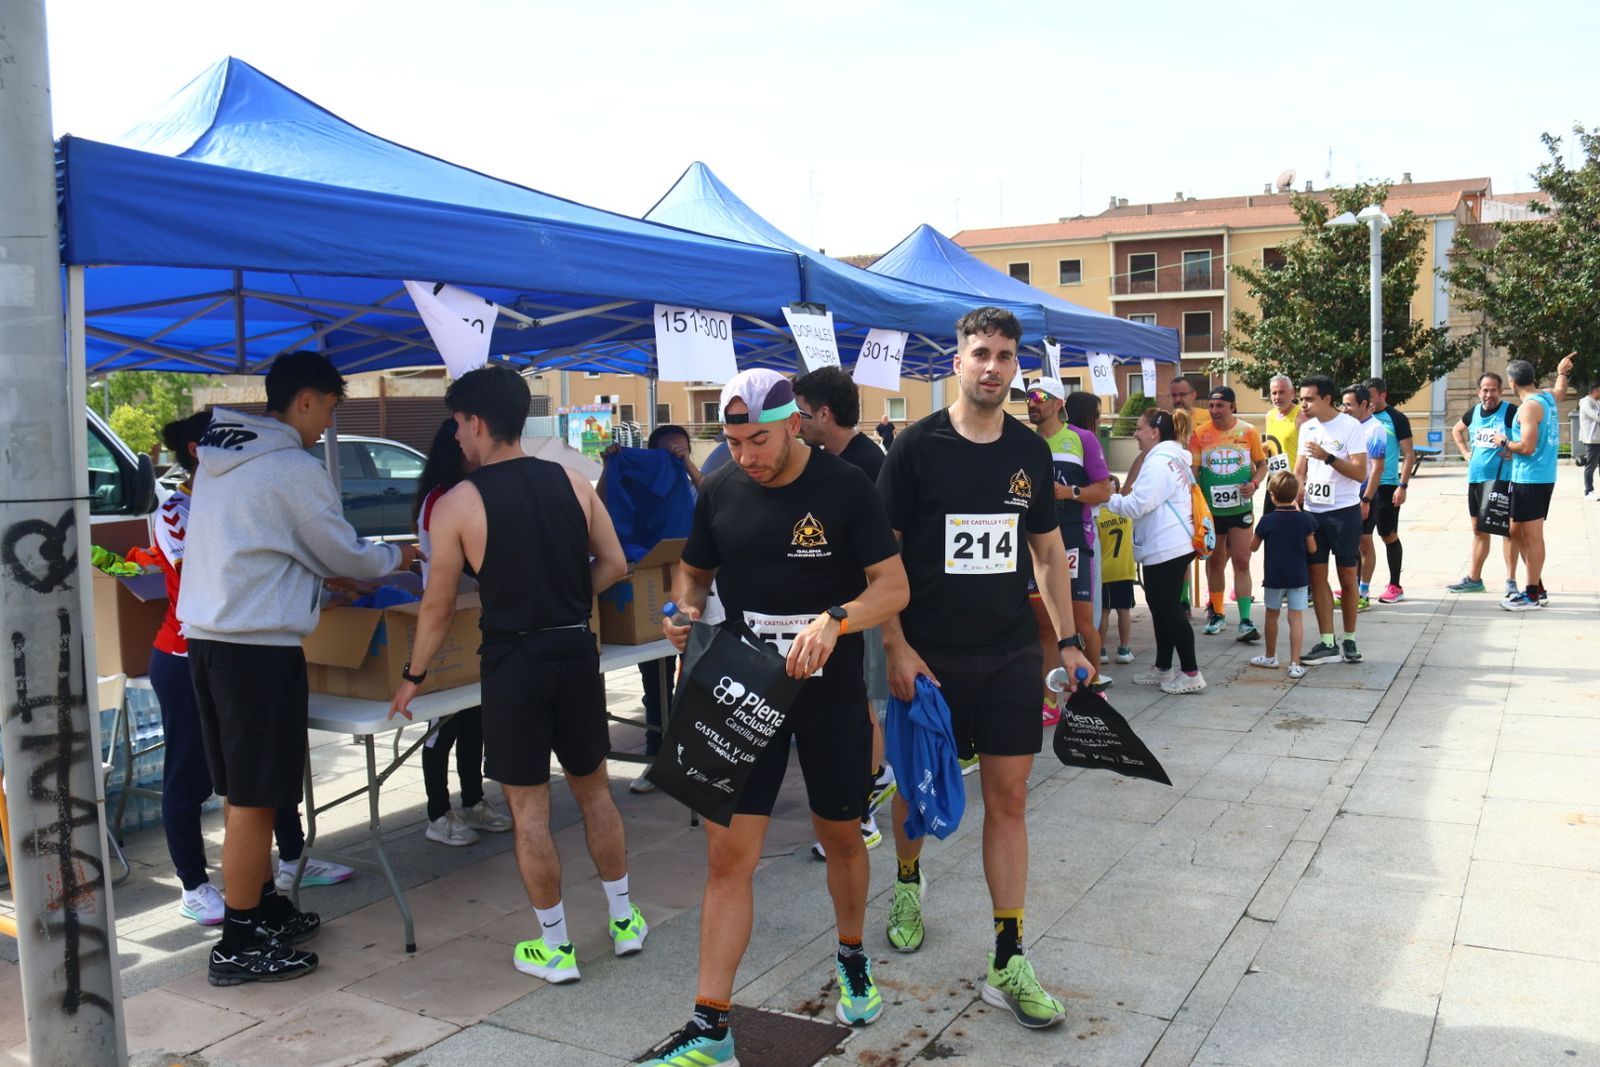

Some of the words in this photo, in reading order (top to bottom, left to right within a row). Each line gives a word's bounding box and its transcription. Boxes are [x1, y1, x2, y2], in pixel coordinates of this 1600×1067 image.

[661, 309, 728, 341] 151-300
[1269, 459, 1287, 472] 435
[1214, 490, 1238, 503] 294
[1307, 482, 1331, 498] 820
[953, 531, 1012, 560] 214
[1108, 528, 1124, 558] 7
[763, 619, 794, 627] CASTILLA
[732, 705, 776, 738] inclusión
[741, 691, 786, 728] Plena
[694, 721, 731, 751] CASTILLA
[732, 746, 741, 757] Y
[725, 717, 756, 742] Castilla
